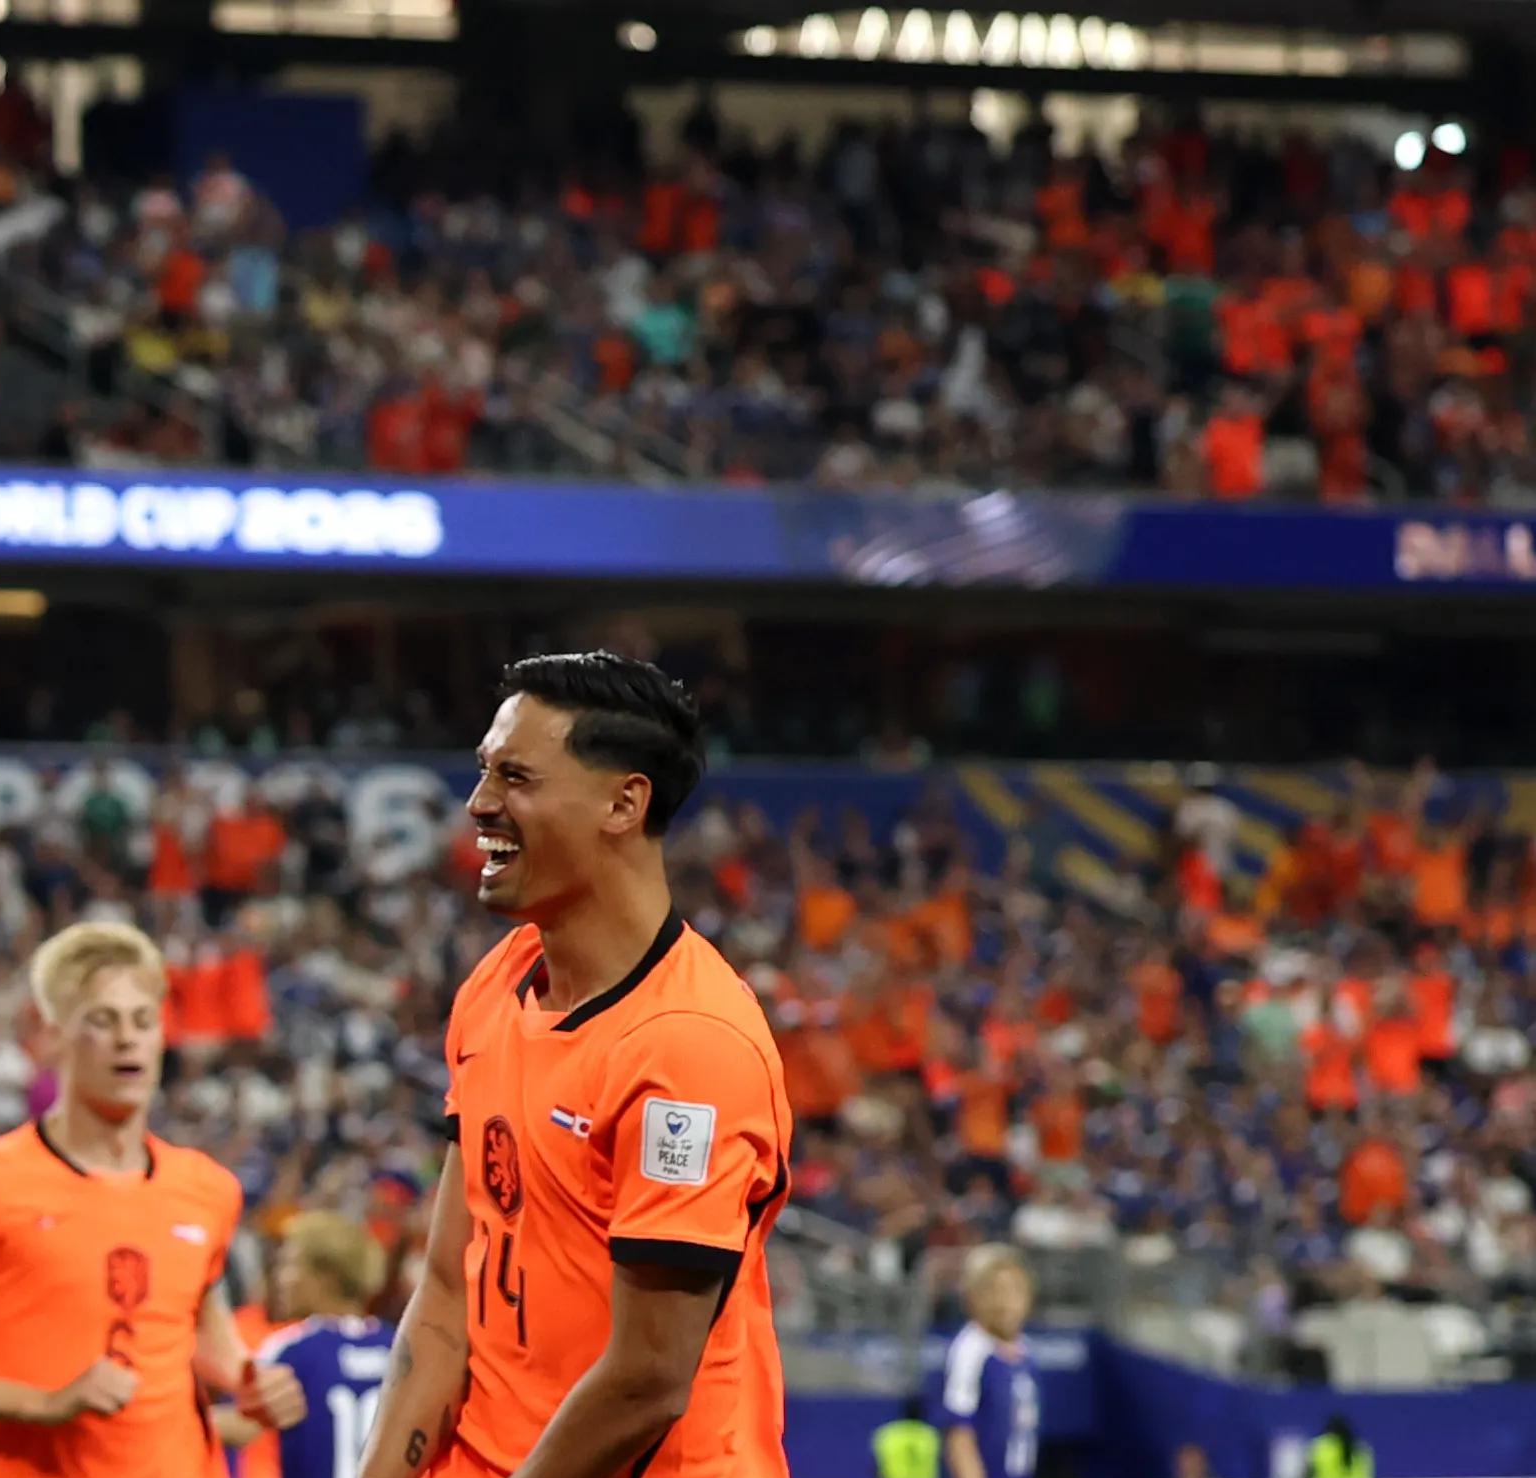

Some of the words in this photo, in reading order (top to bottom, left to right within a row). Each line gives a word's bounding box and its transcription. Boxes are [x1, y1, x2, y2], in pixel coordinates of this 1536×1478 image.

[119, 483, 238, 551] CUP
[234, 487, 444, 558] 2026
[658, 1149, 689, 1167] PEACE
